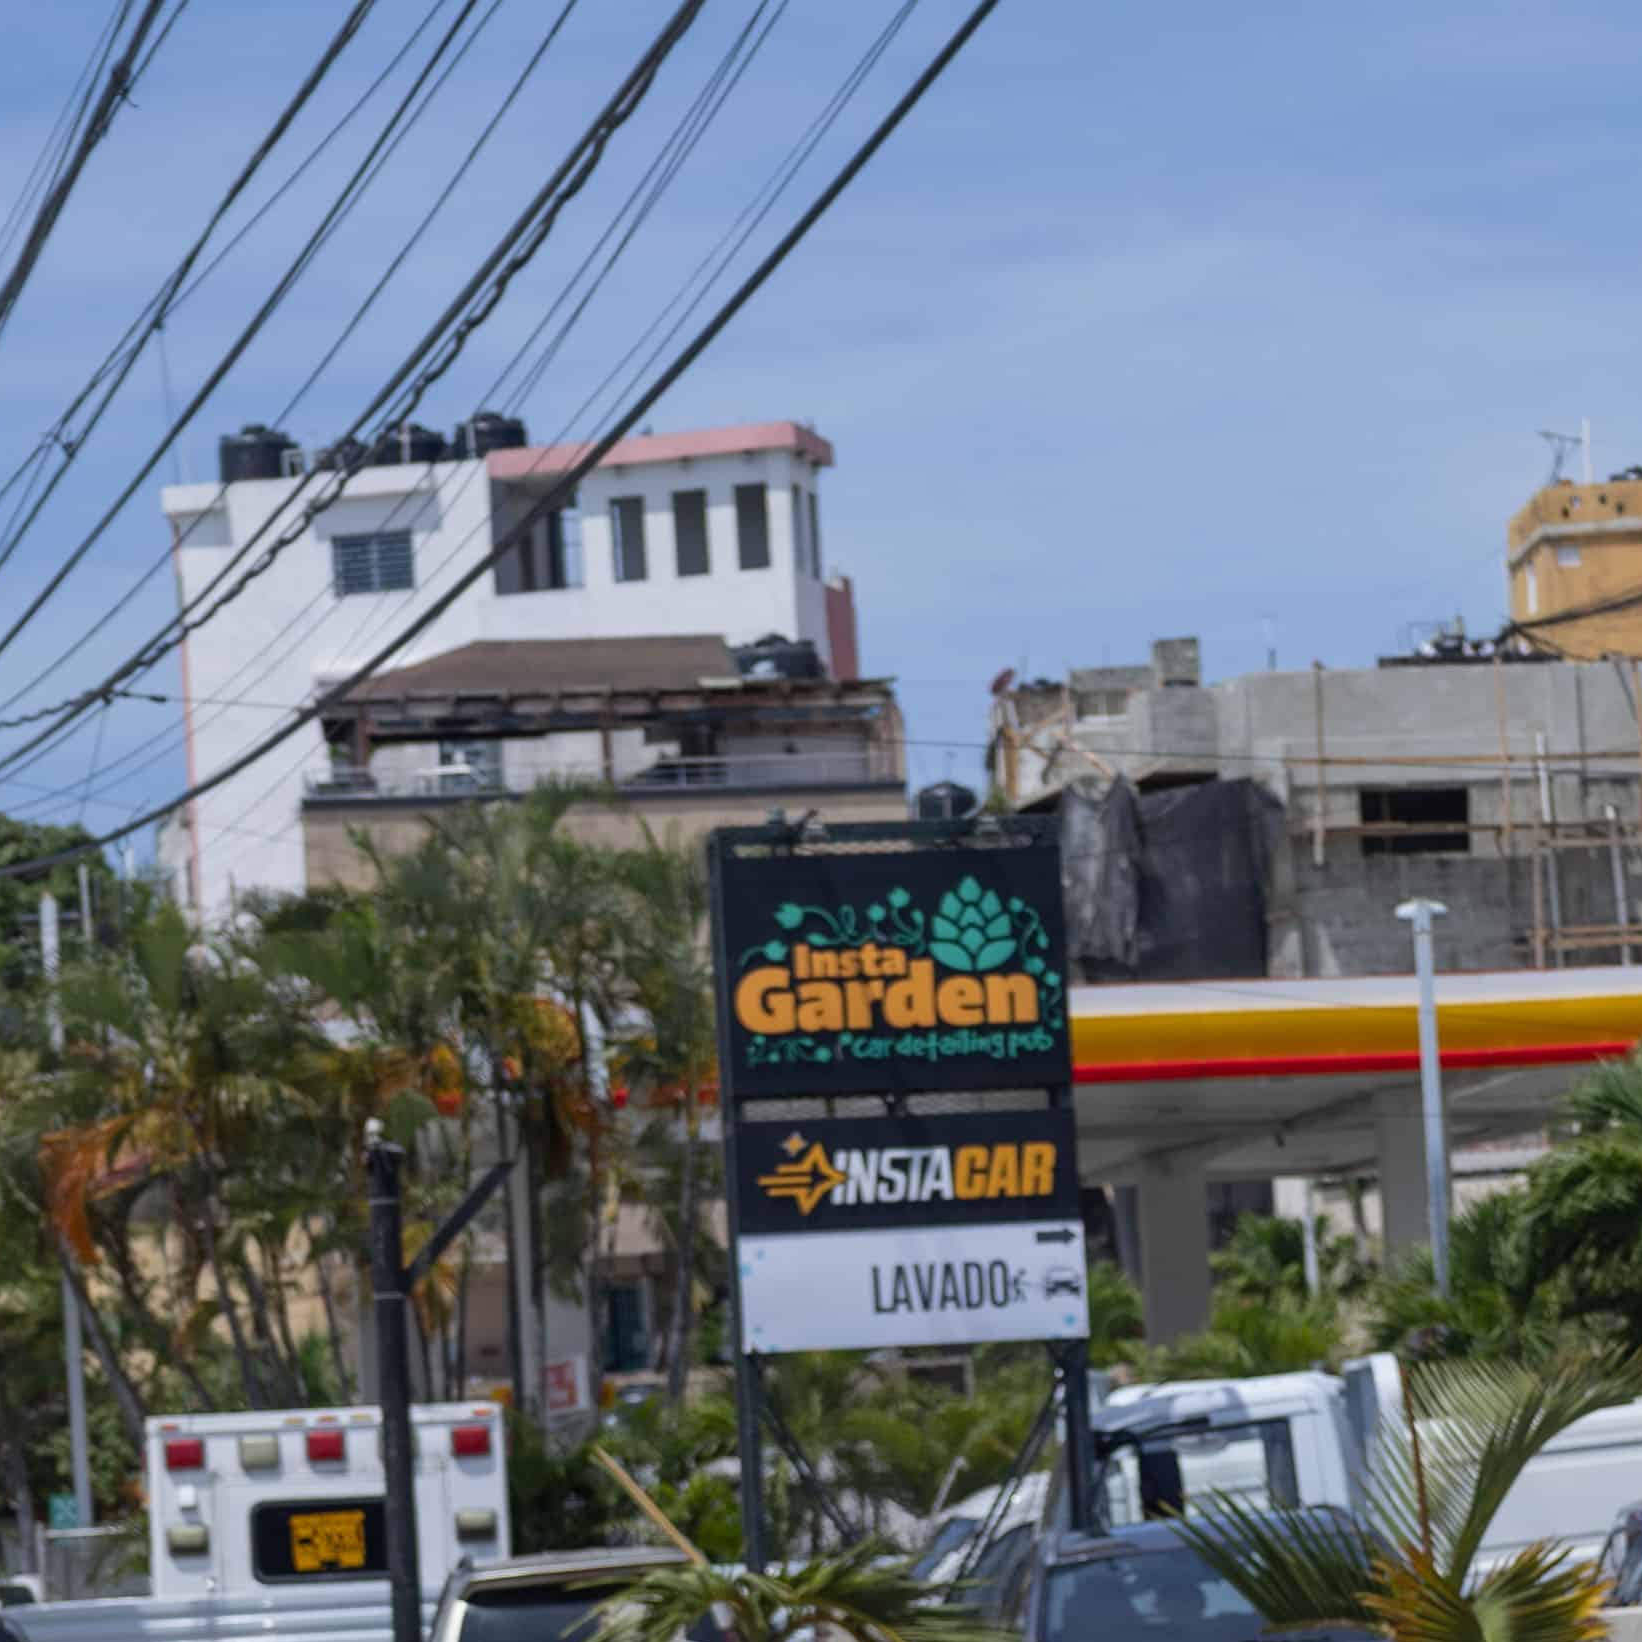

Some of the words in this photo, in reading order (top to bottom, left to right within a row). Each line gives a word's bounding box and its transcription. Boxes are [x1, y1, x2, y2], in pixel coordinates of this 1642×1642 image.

[793, 942, 907, 980] Insta
[734, 958, 1040, 1035] Garden
[852, 1037, 893, 1059] car
[1008, 1026, 1054, 1059] pub
[831, 1141, 1058, 1206] INSTACAR
[872, 1260, 1010, 1314] LAVADO
